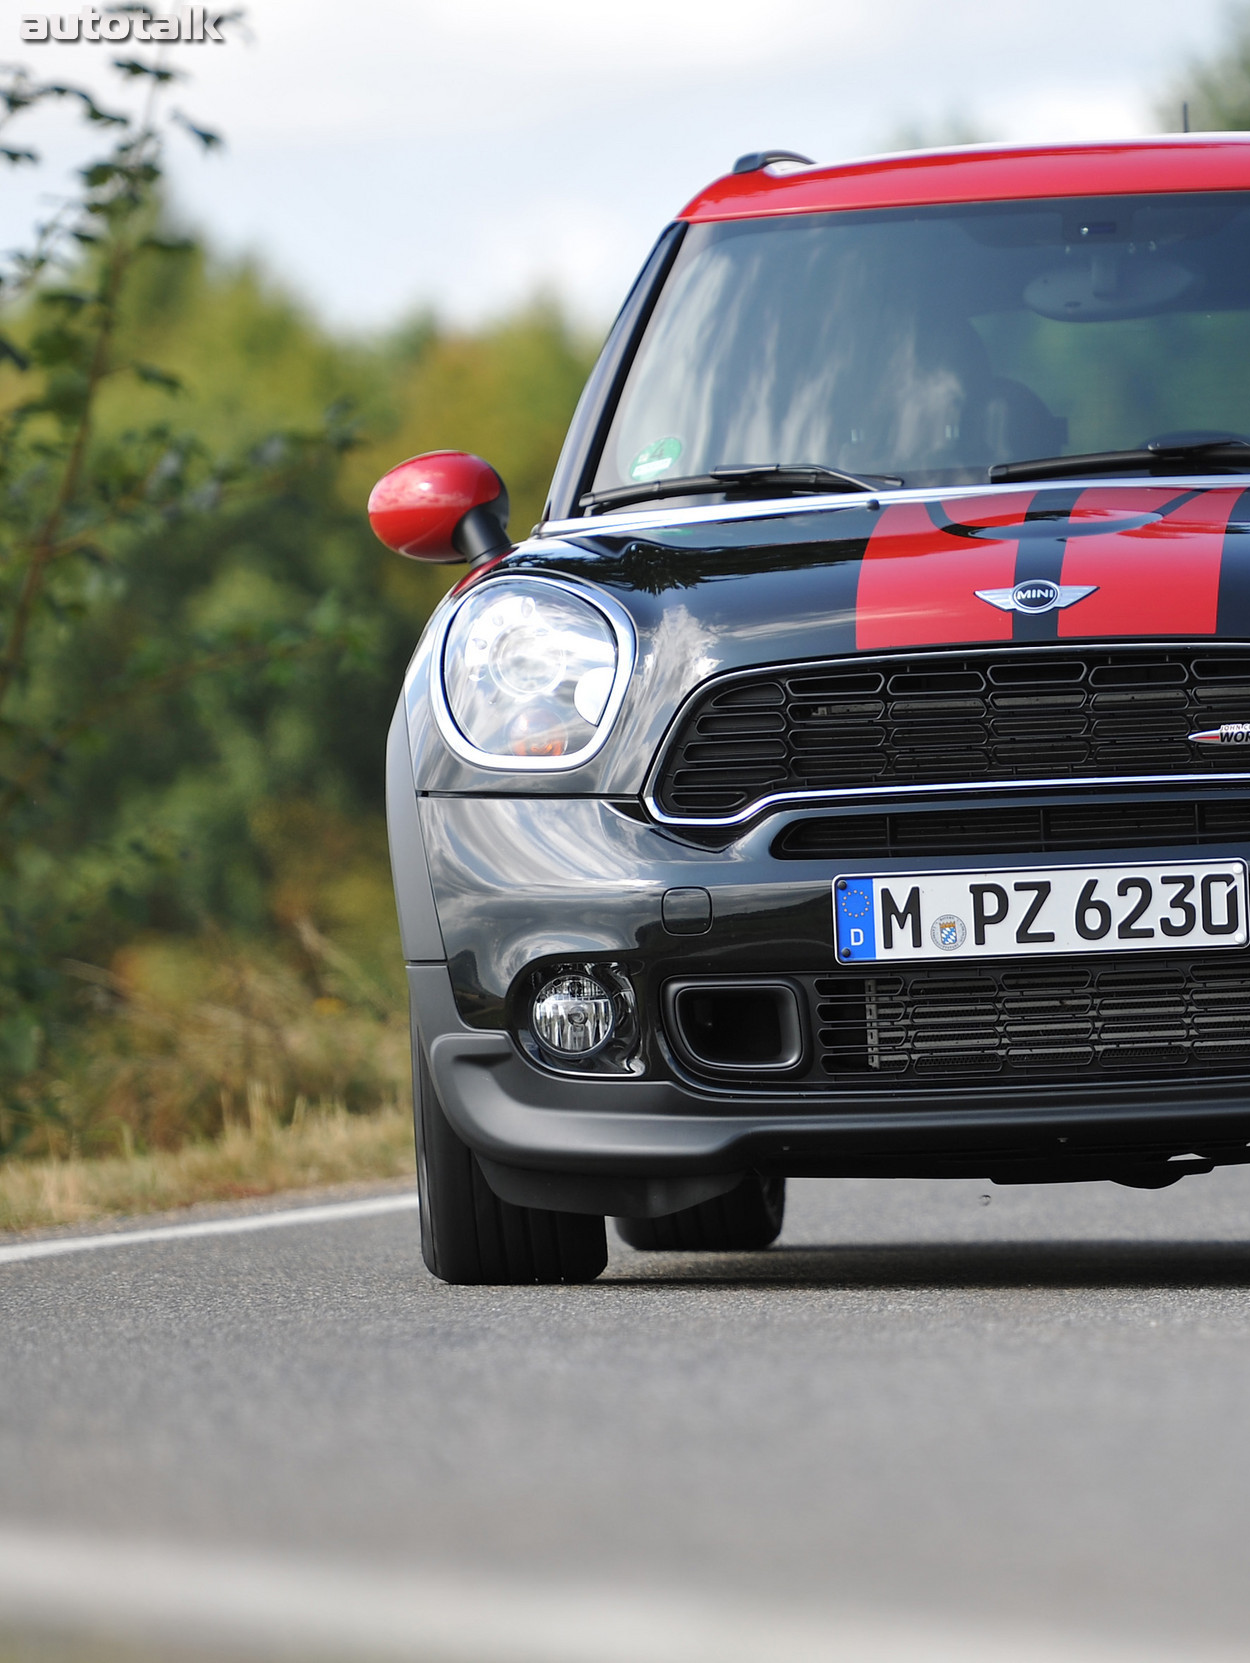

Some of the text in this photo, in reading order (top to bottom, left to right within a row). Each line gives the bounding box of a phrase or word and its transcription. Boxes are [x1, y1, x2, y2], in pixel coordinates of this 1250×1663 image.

[1016, 589, 1054, 600] MINI
[880, 886, 922, 949] M
[969, 880, 1056, 946] PZ
[1075, 873, 1240, 941] 6230
[850, 928, 864, 946] D
